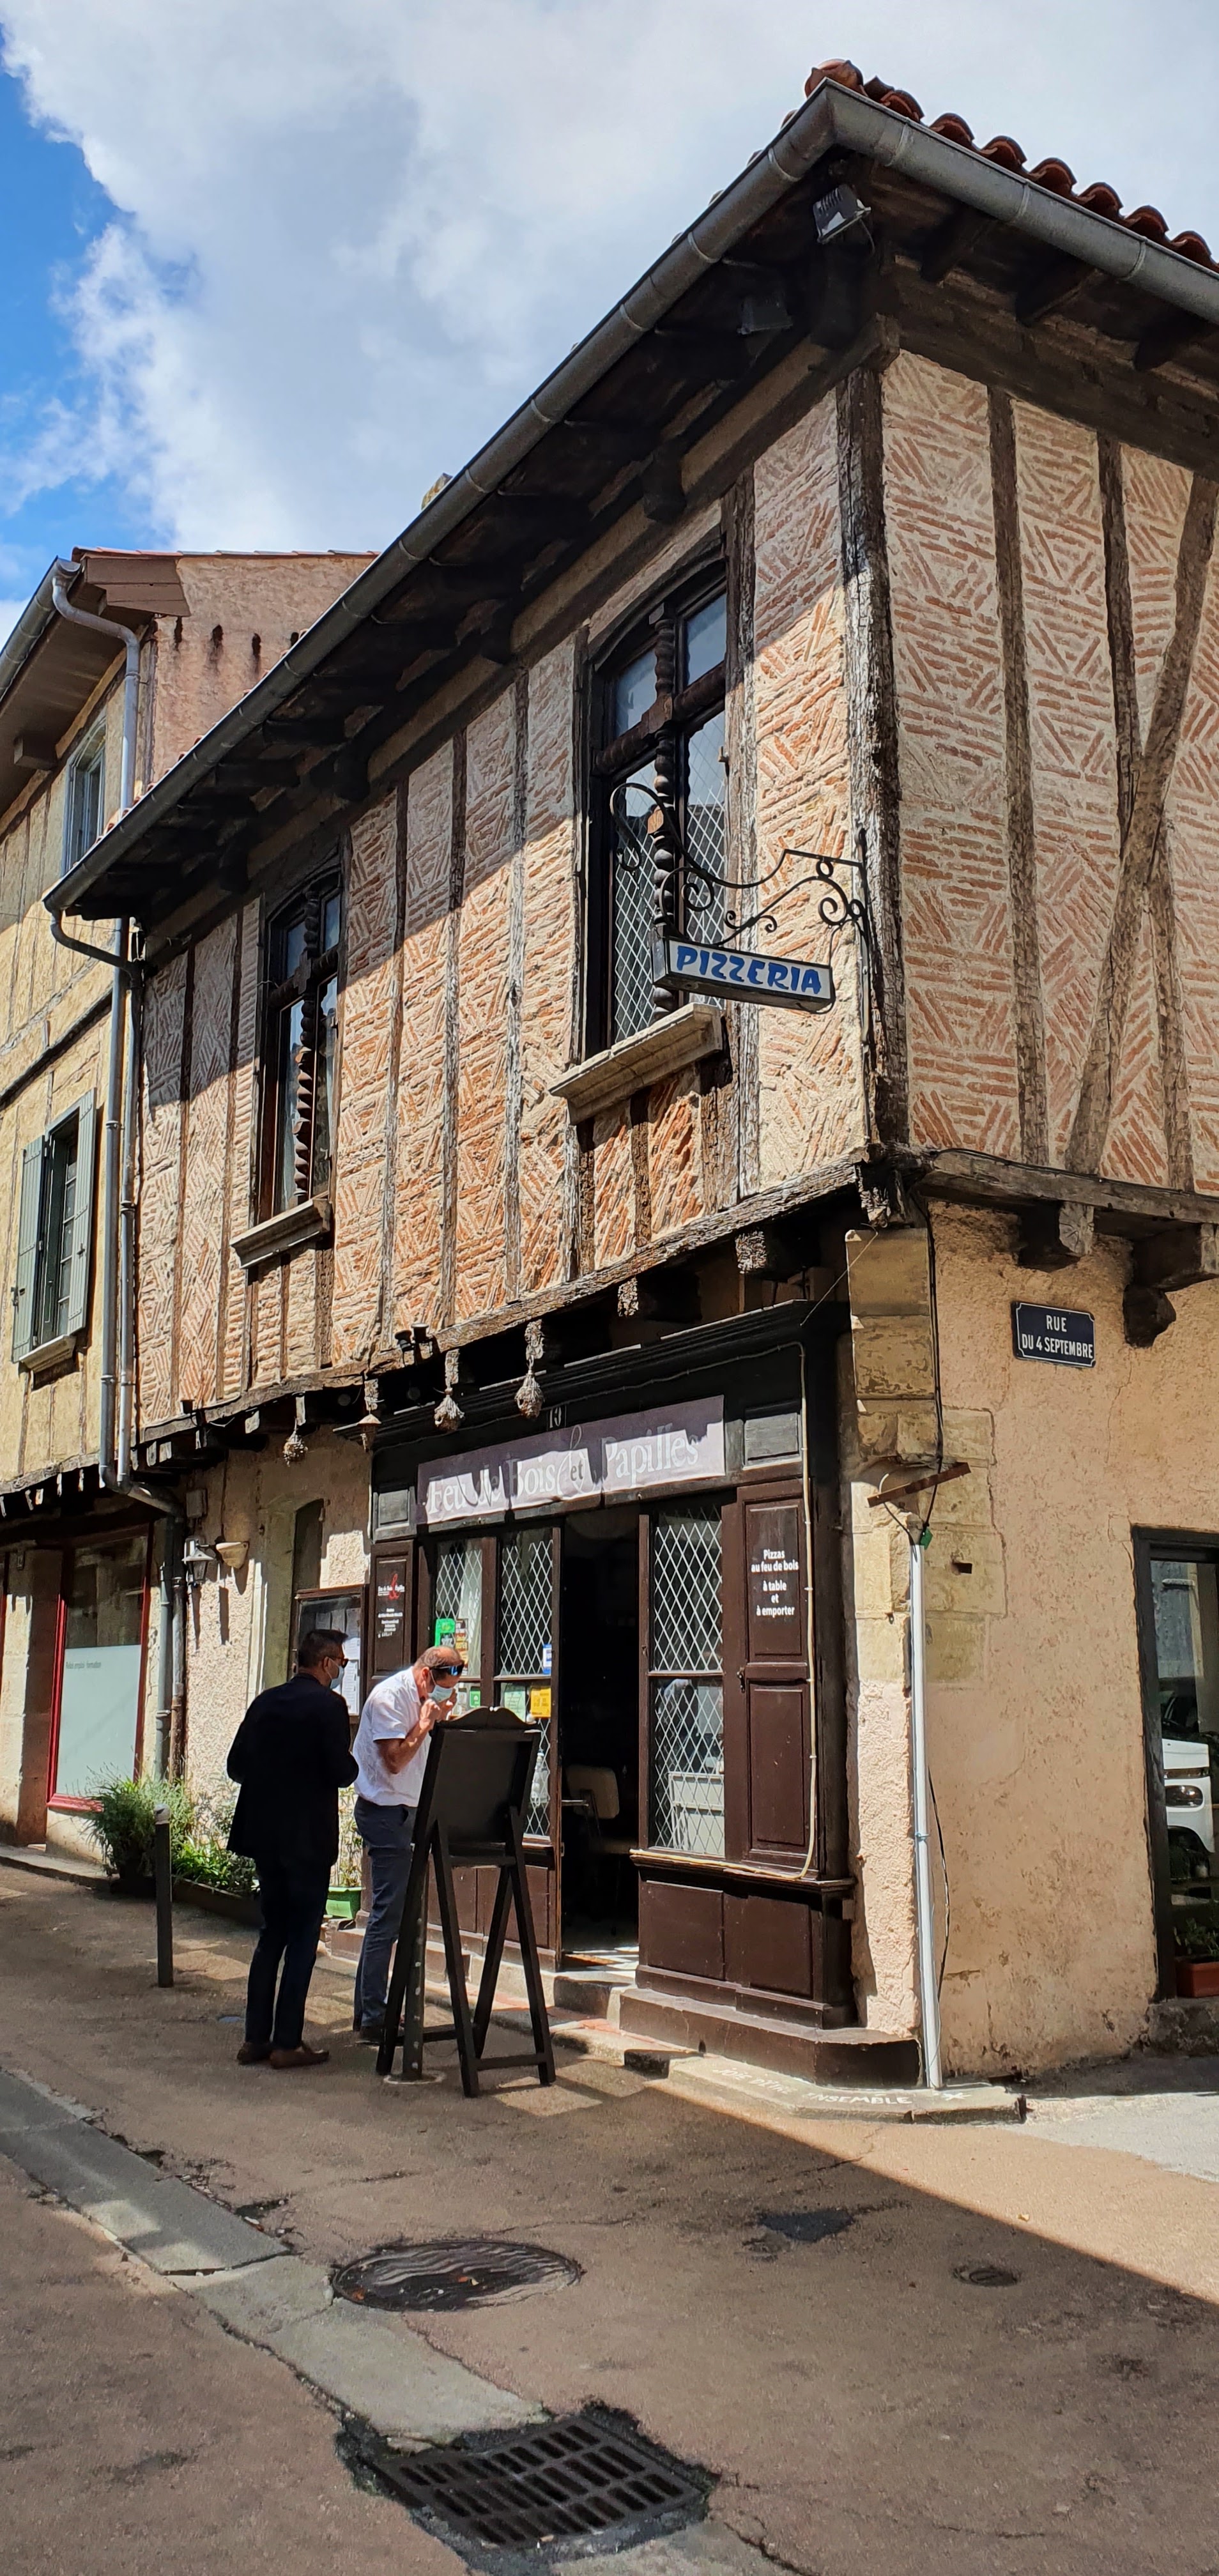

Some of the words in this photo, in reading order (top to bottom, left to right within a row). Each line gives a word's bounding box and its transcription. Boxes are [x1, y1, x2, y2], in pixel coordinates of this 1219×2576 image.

[677, 946, 822, 995] PIZZERIA
[1046, 1315, 1067, 1332] RUE
[1022, 1333, 1034, 1350] DU
[1036, 1336, 1043, 1351] 4
[1044, 1337, 1093, 1359] SEPTEMBRE
[549, 1407, 562, 1429] 13
[429, 1473, 468, 1514] Feu
[506, 1455, 555, 1499] Bois
[601, 1422, 698, 1489] Papilles
[570, 1462, 583, 1482] et
[763, 1549, 785, 1560] Pizzas
[751, 1564, 760, 1572] au
[761, 1561, 772, 1572] feu
[773, 1560, 783, 1571] de
[783, 1559, 799, 1571] bois
[763, 1580, 768, 1591] à
[769, 1579, 787, 1591] table
[771, 1593, 779, 1604] et
[756, 1605, 762, 1616] à
[762, 1606, 795, 1618] emporter
